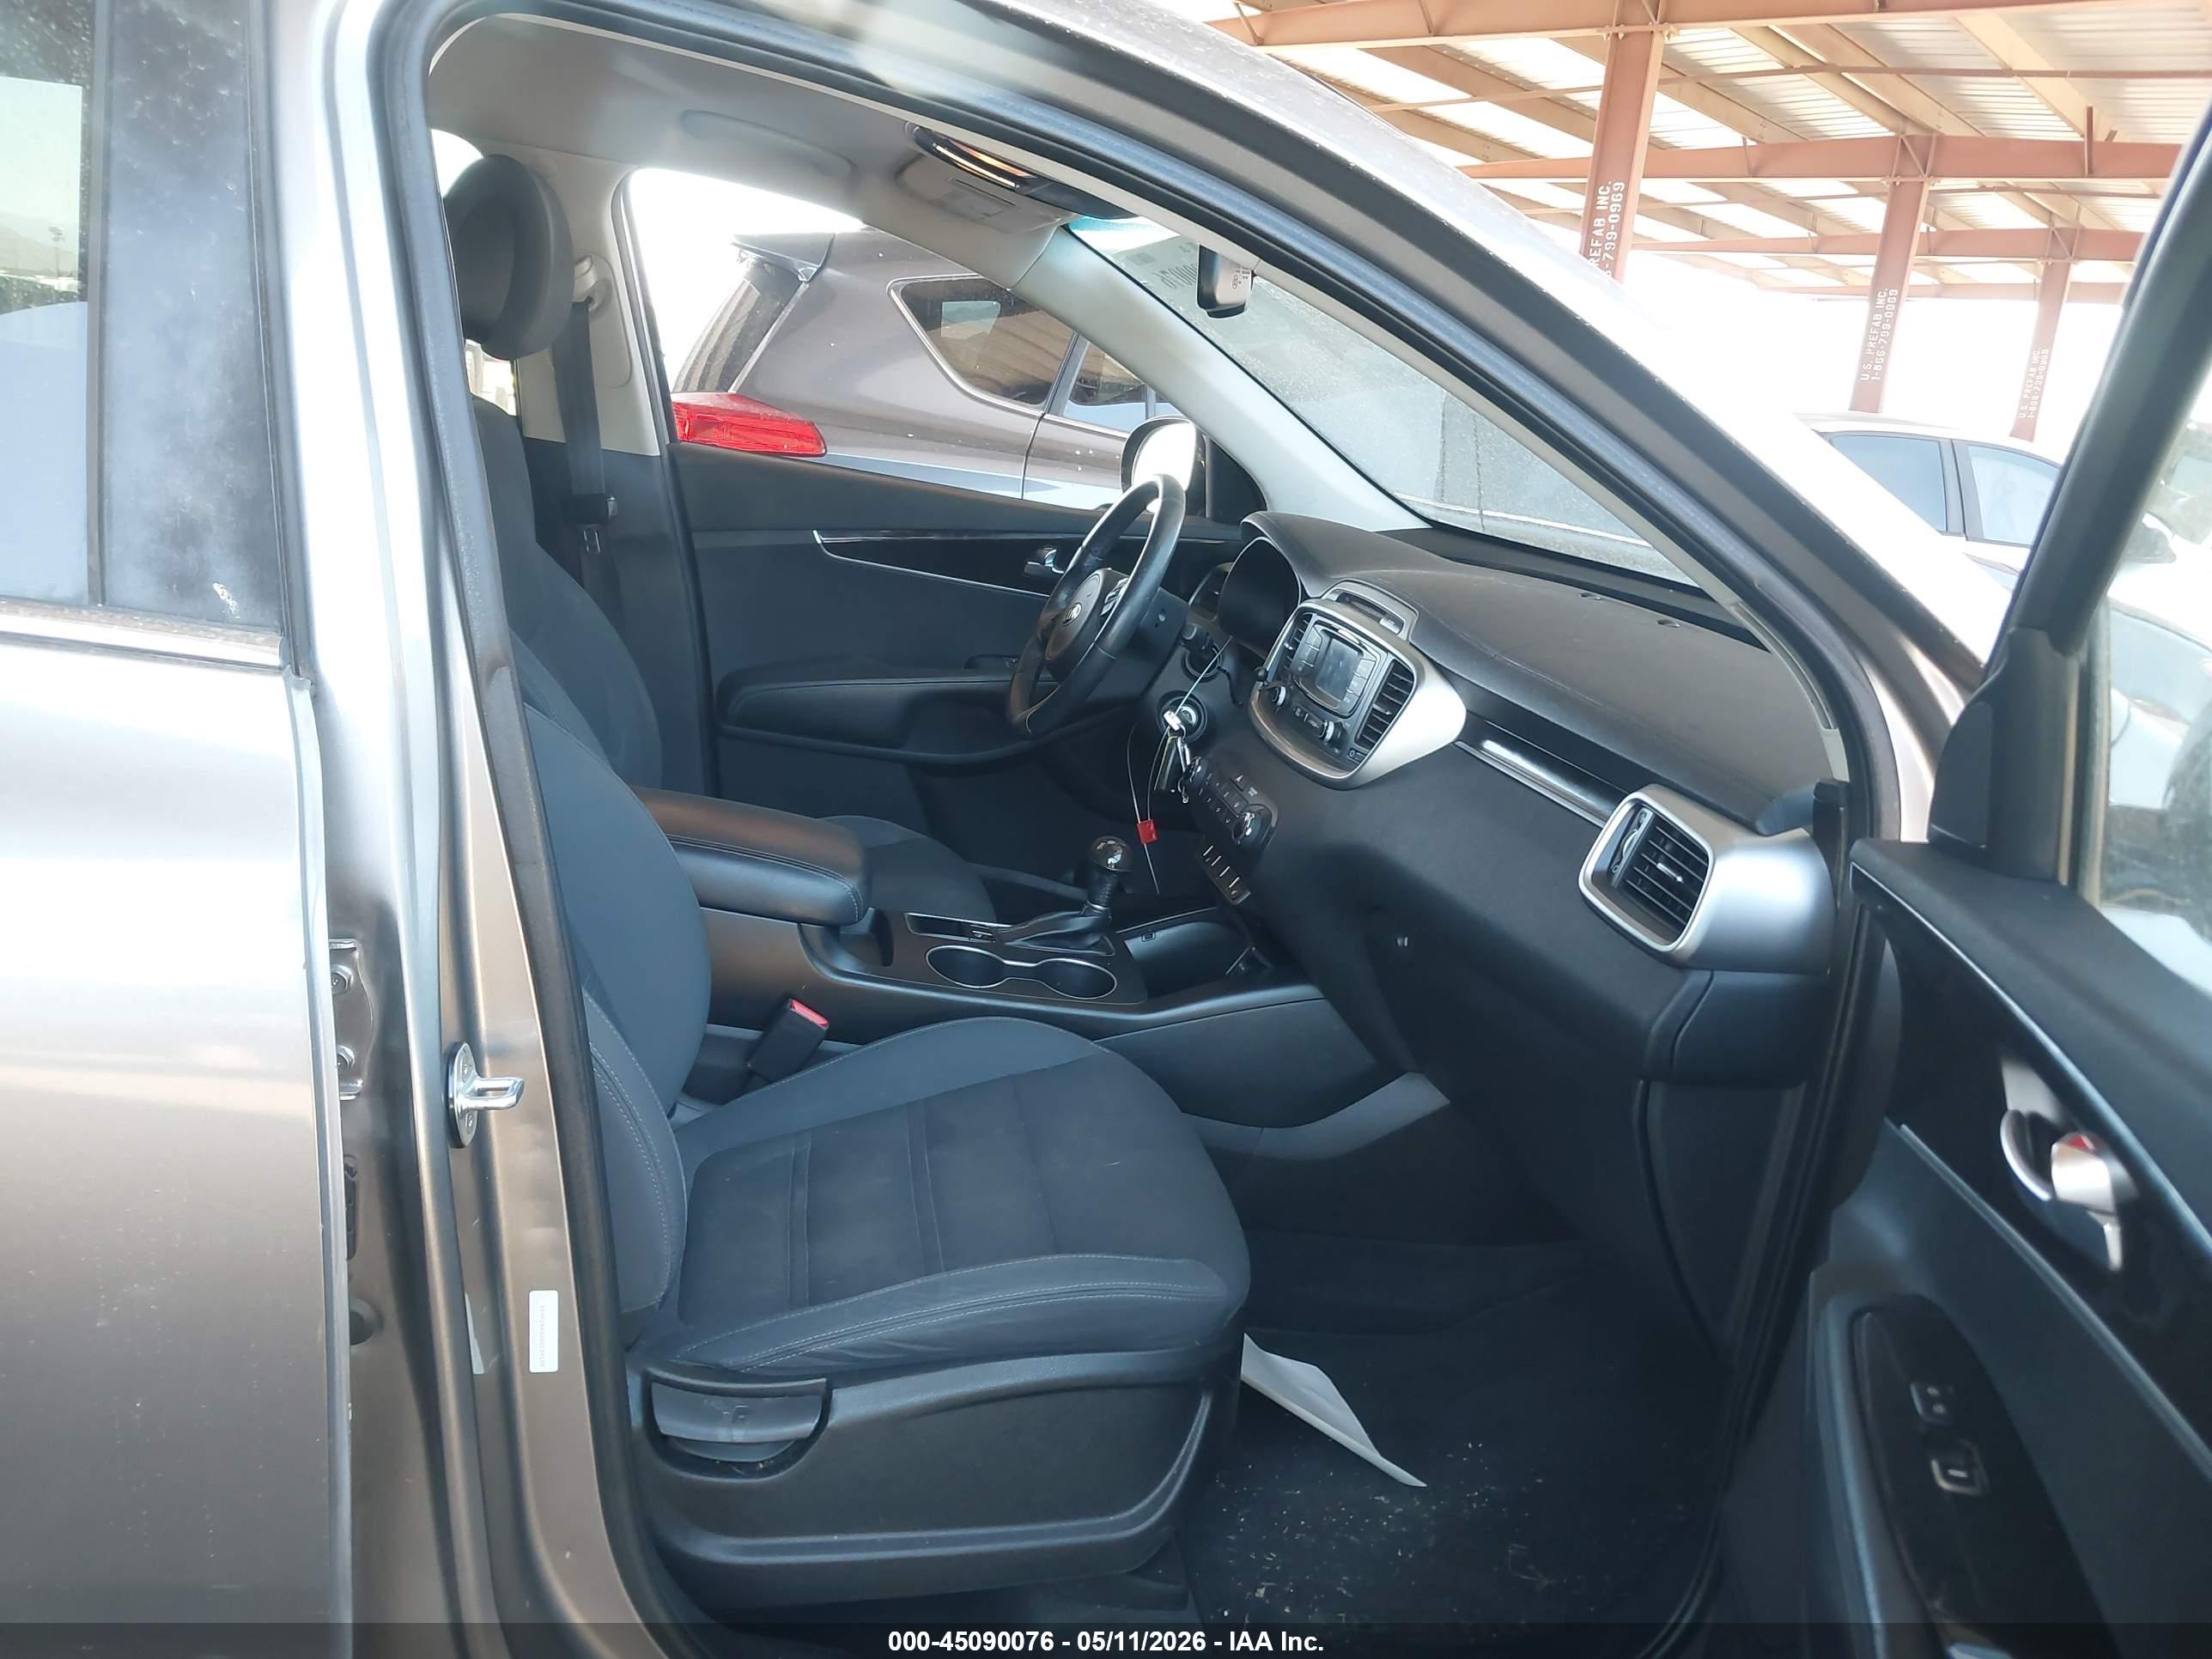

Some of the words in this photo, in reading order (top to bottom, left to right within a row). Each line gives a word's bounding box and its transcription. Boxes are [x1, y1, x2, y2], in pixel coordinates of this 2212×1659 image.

[1595, 180, 1612, 210] INC.
[1589, 217, 1606, 267] REFAB
[1875, 288, 1888, 309] INC.
[1865, 313, 1883, 355] PREFAB
[1859, 360, 1874, 381] U.S.
